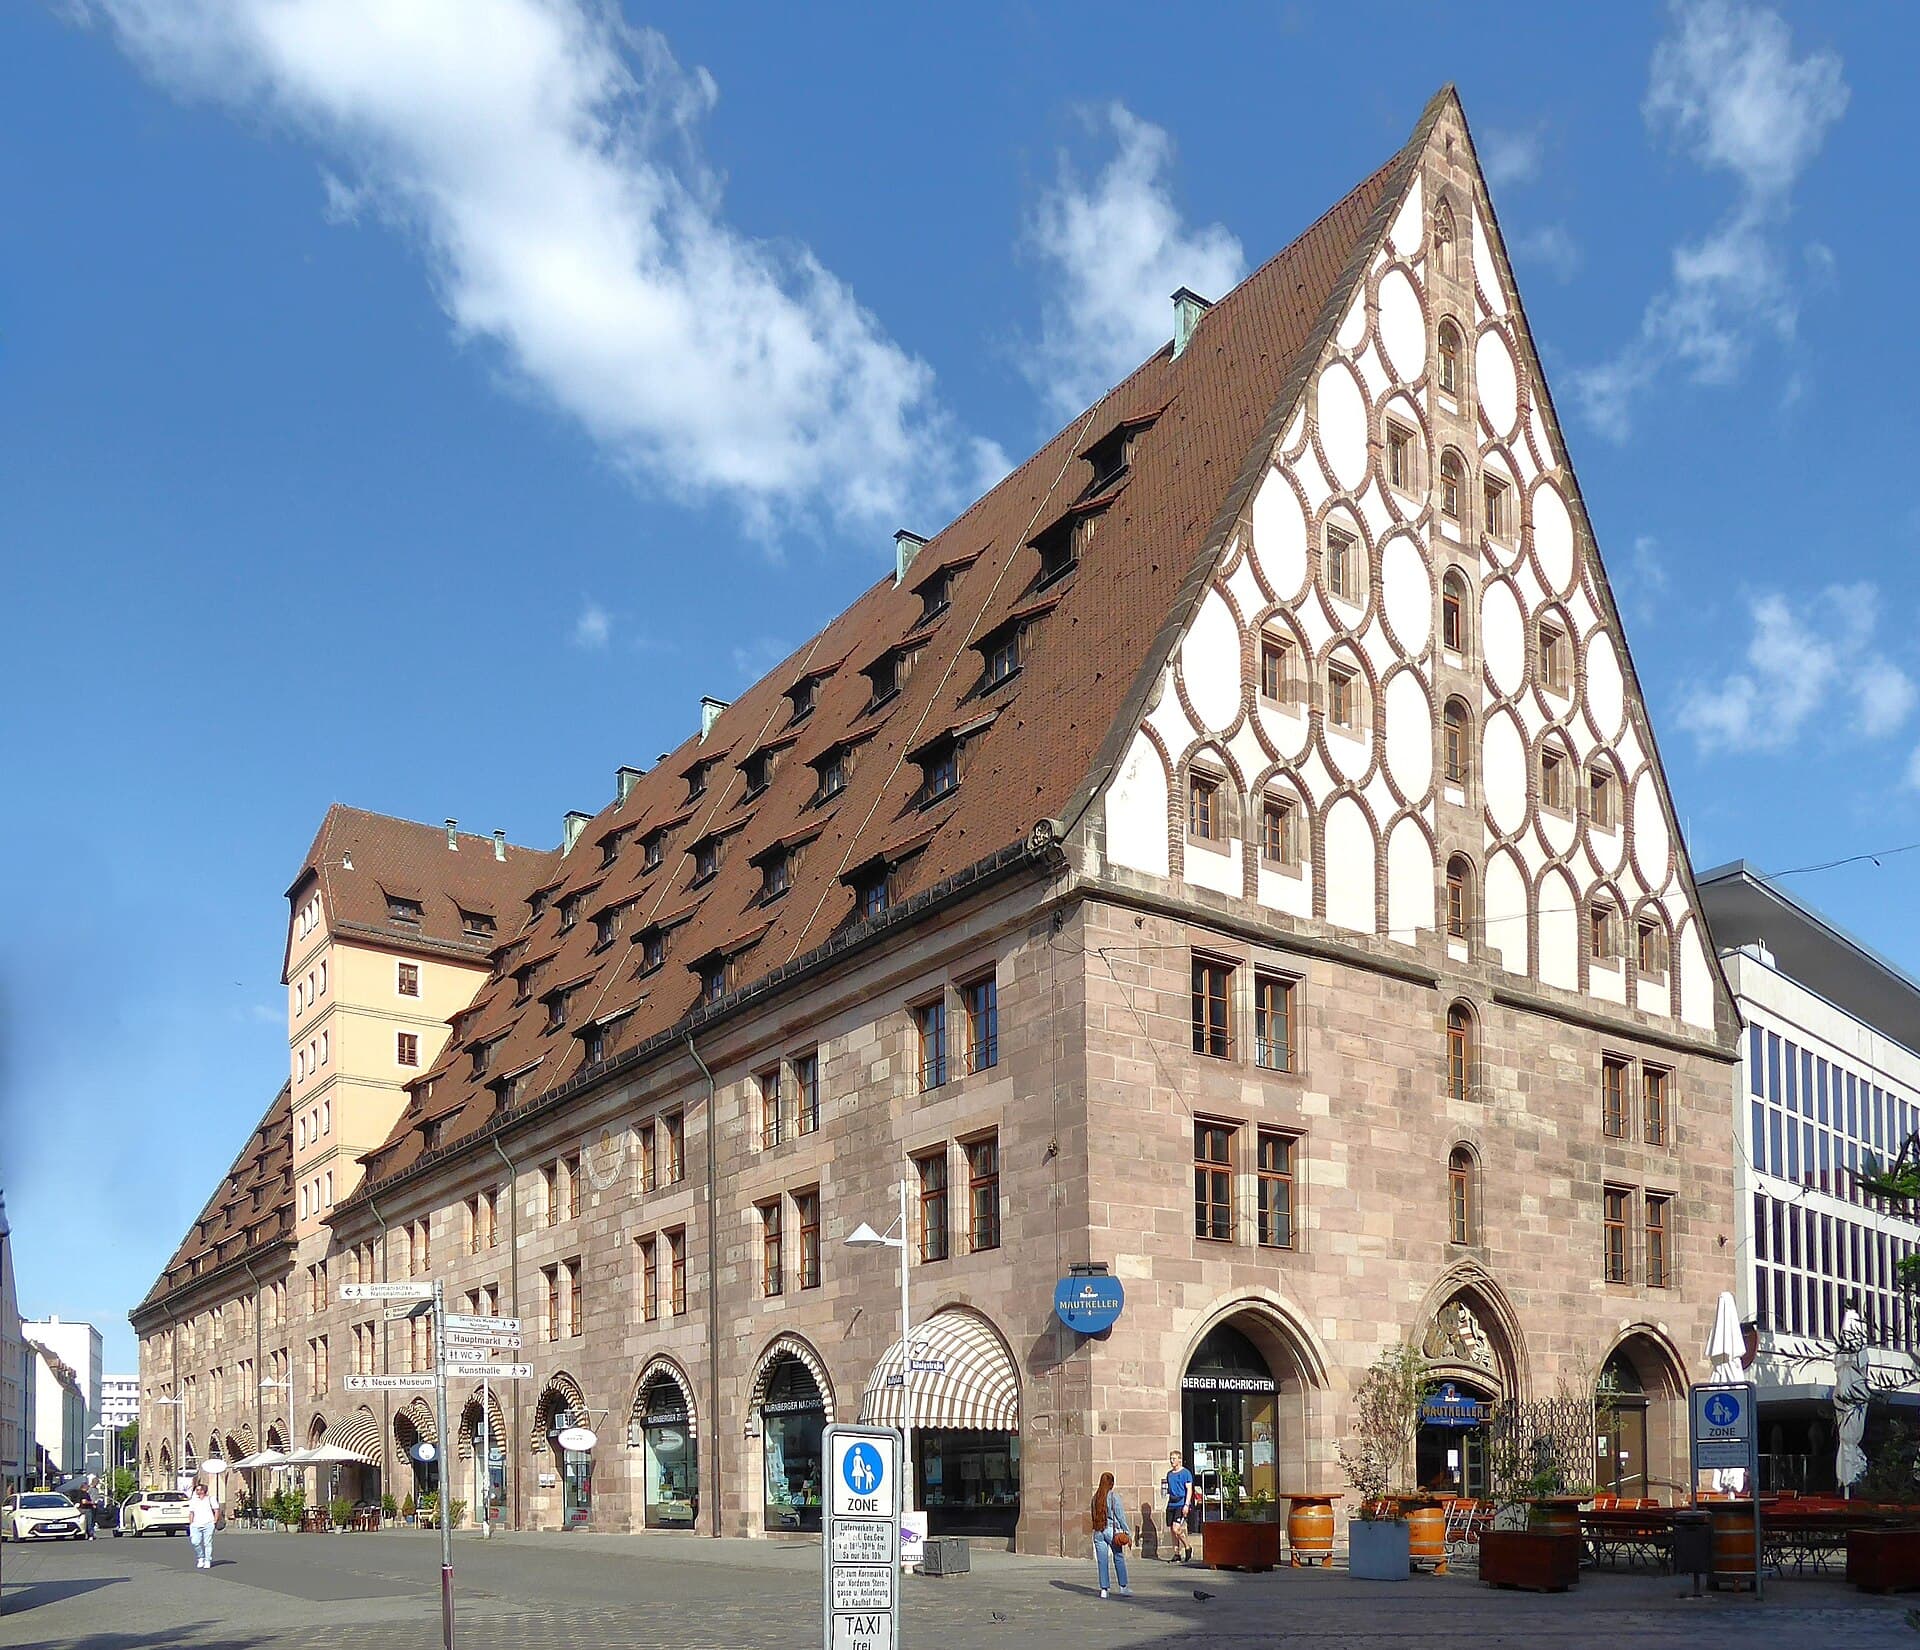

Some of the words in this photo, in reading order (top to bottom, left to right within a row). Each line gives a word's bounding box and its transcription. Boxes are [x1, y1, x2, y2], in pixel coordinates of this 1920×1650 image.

[1059, 1300, 1118, 1309] MAUTKELLER
[454, 1334, 501, 1345] Hauptmarkt
[460, 1351, 473, 1360] WC
[458, 1366, 501, 1375] Kunsthalle
[372, 1378, 397, 1386] Neues
[399, 1377, 432, 1386] Museum
[1182, 1377, 1217, 1388] BERGER
[1218, 1379, 1274, 1390] NACHRICHTEN
[1709, 1427, 1736, 1437] ZONE
[847, 1498, 879, 1512] ZONE
[840, 1522, 874, 1532] Lieferverkehr
[876, 1524, 884, 1533] bis
[842, 1551, 849, 1559] Sa
[850, 1552, 860, 1560] nur
[861, 1551, 870, 1560] bis
[858, 1569, 884, 1578] Kornmarkt
[848, 1579, 870, 1587] Vorderen
[836, 1589, 852, 1598] gasse
[860, 1588, 888, 1598] Anlieferung
[851, 1598, 871, 1606] Kaufhof
[844, 1615, 881, 1636] TAXI
[852, 1639, 871, 1650] frei
